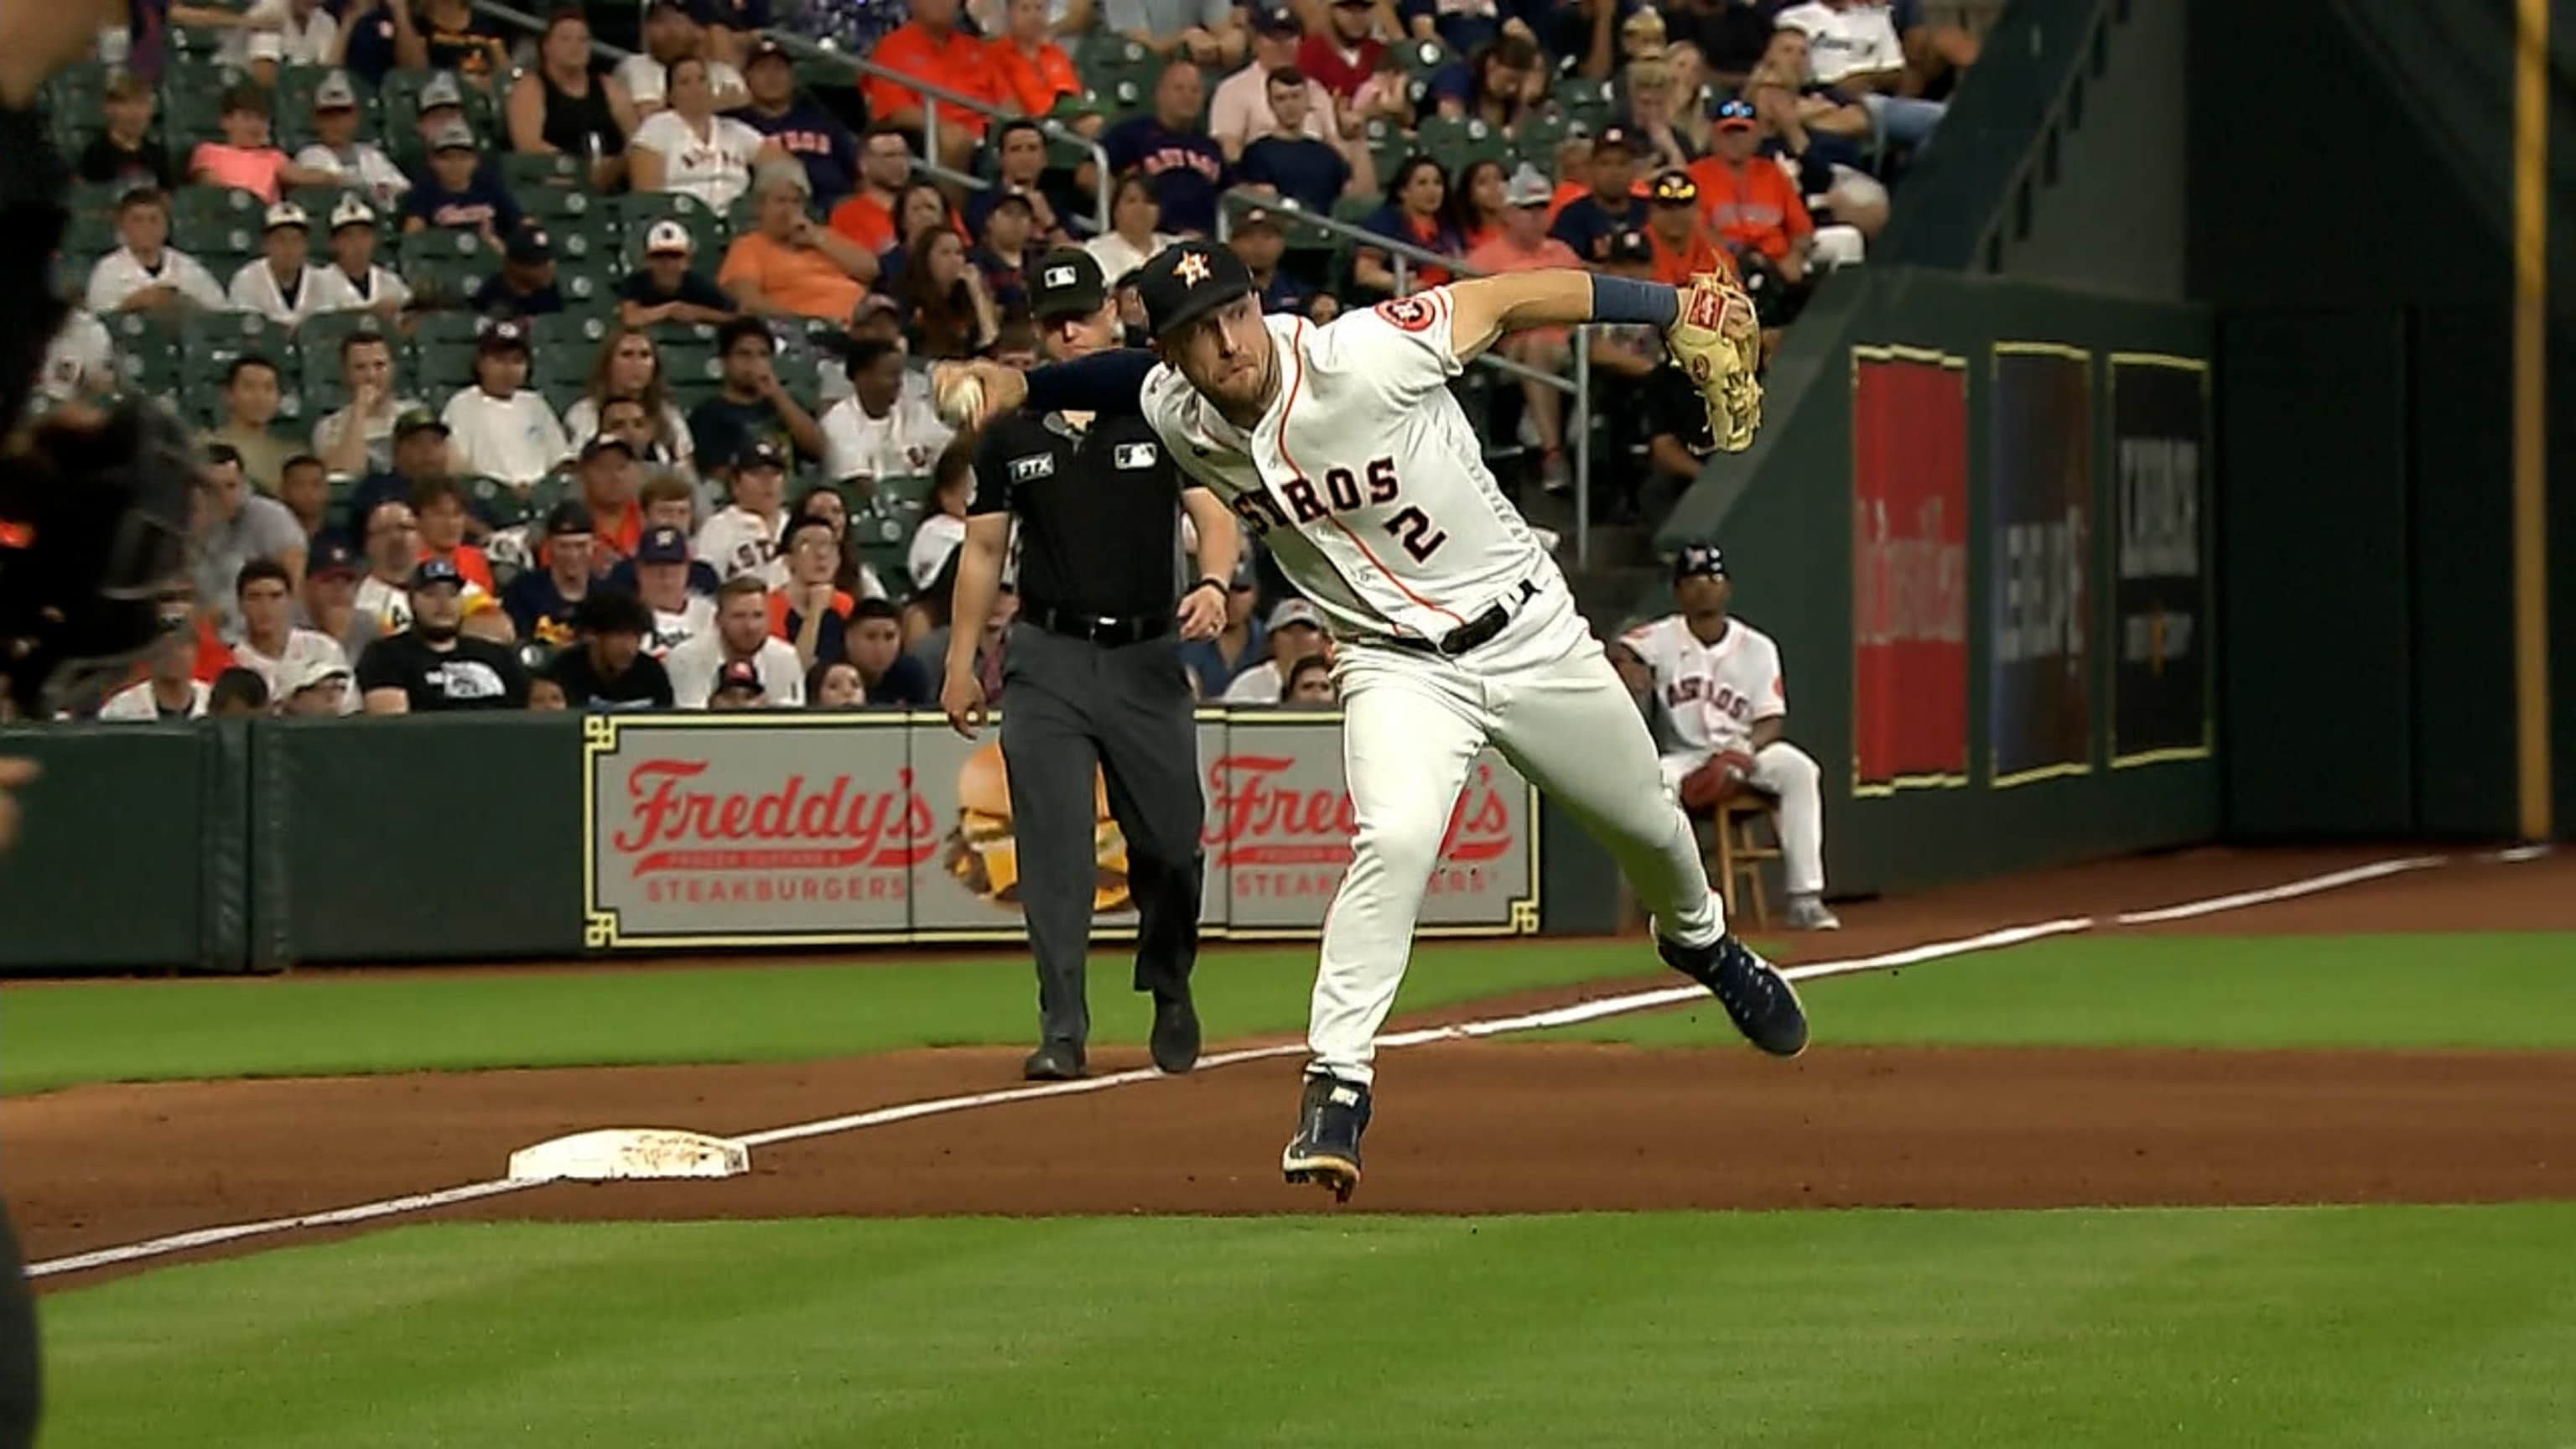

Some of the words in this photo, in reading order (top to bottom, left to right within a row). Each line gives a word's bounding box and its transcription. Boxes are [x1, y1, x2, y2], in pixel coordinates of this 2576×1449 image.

[1232, 455, 1400, 536] STROS
[1381, 505, 1448, 564] 2
[613, 759, 937, 857] Freddy's
[1201, 756, 1509, 857] Frey's
[646, 877, 910, 903] STEAKBURGERS
[1235, 870, 1489, 897] STEAKERS
